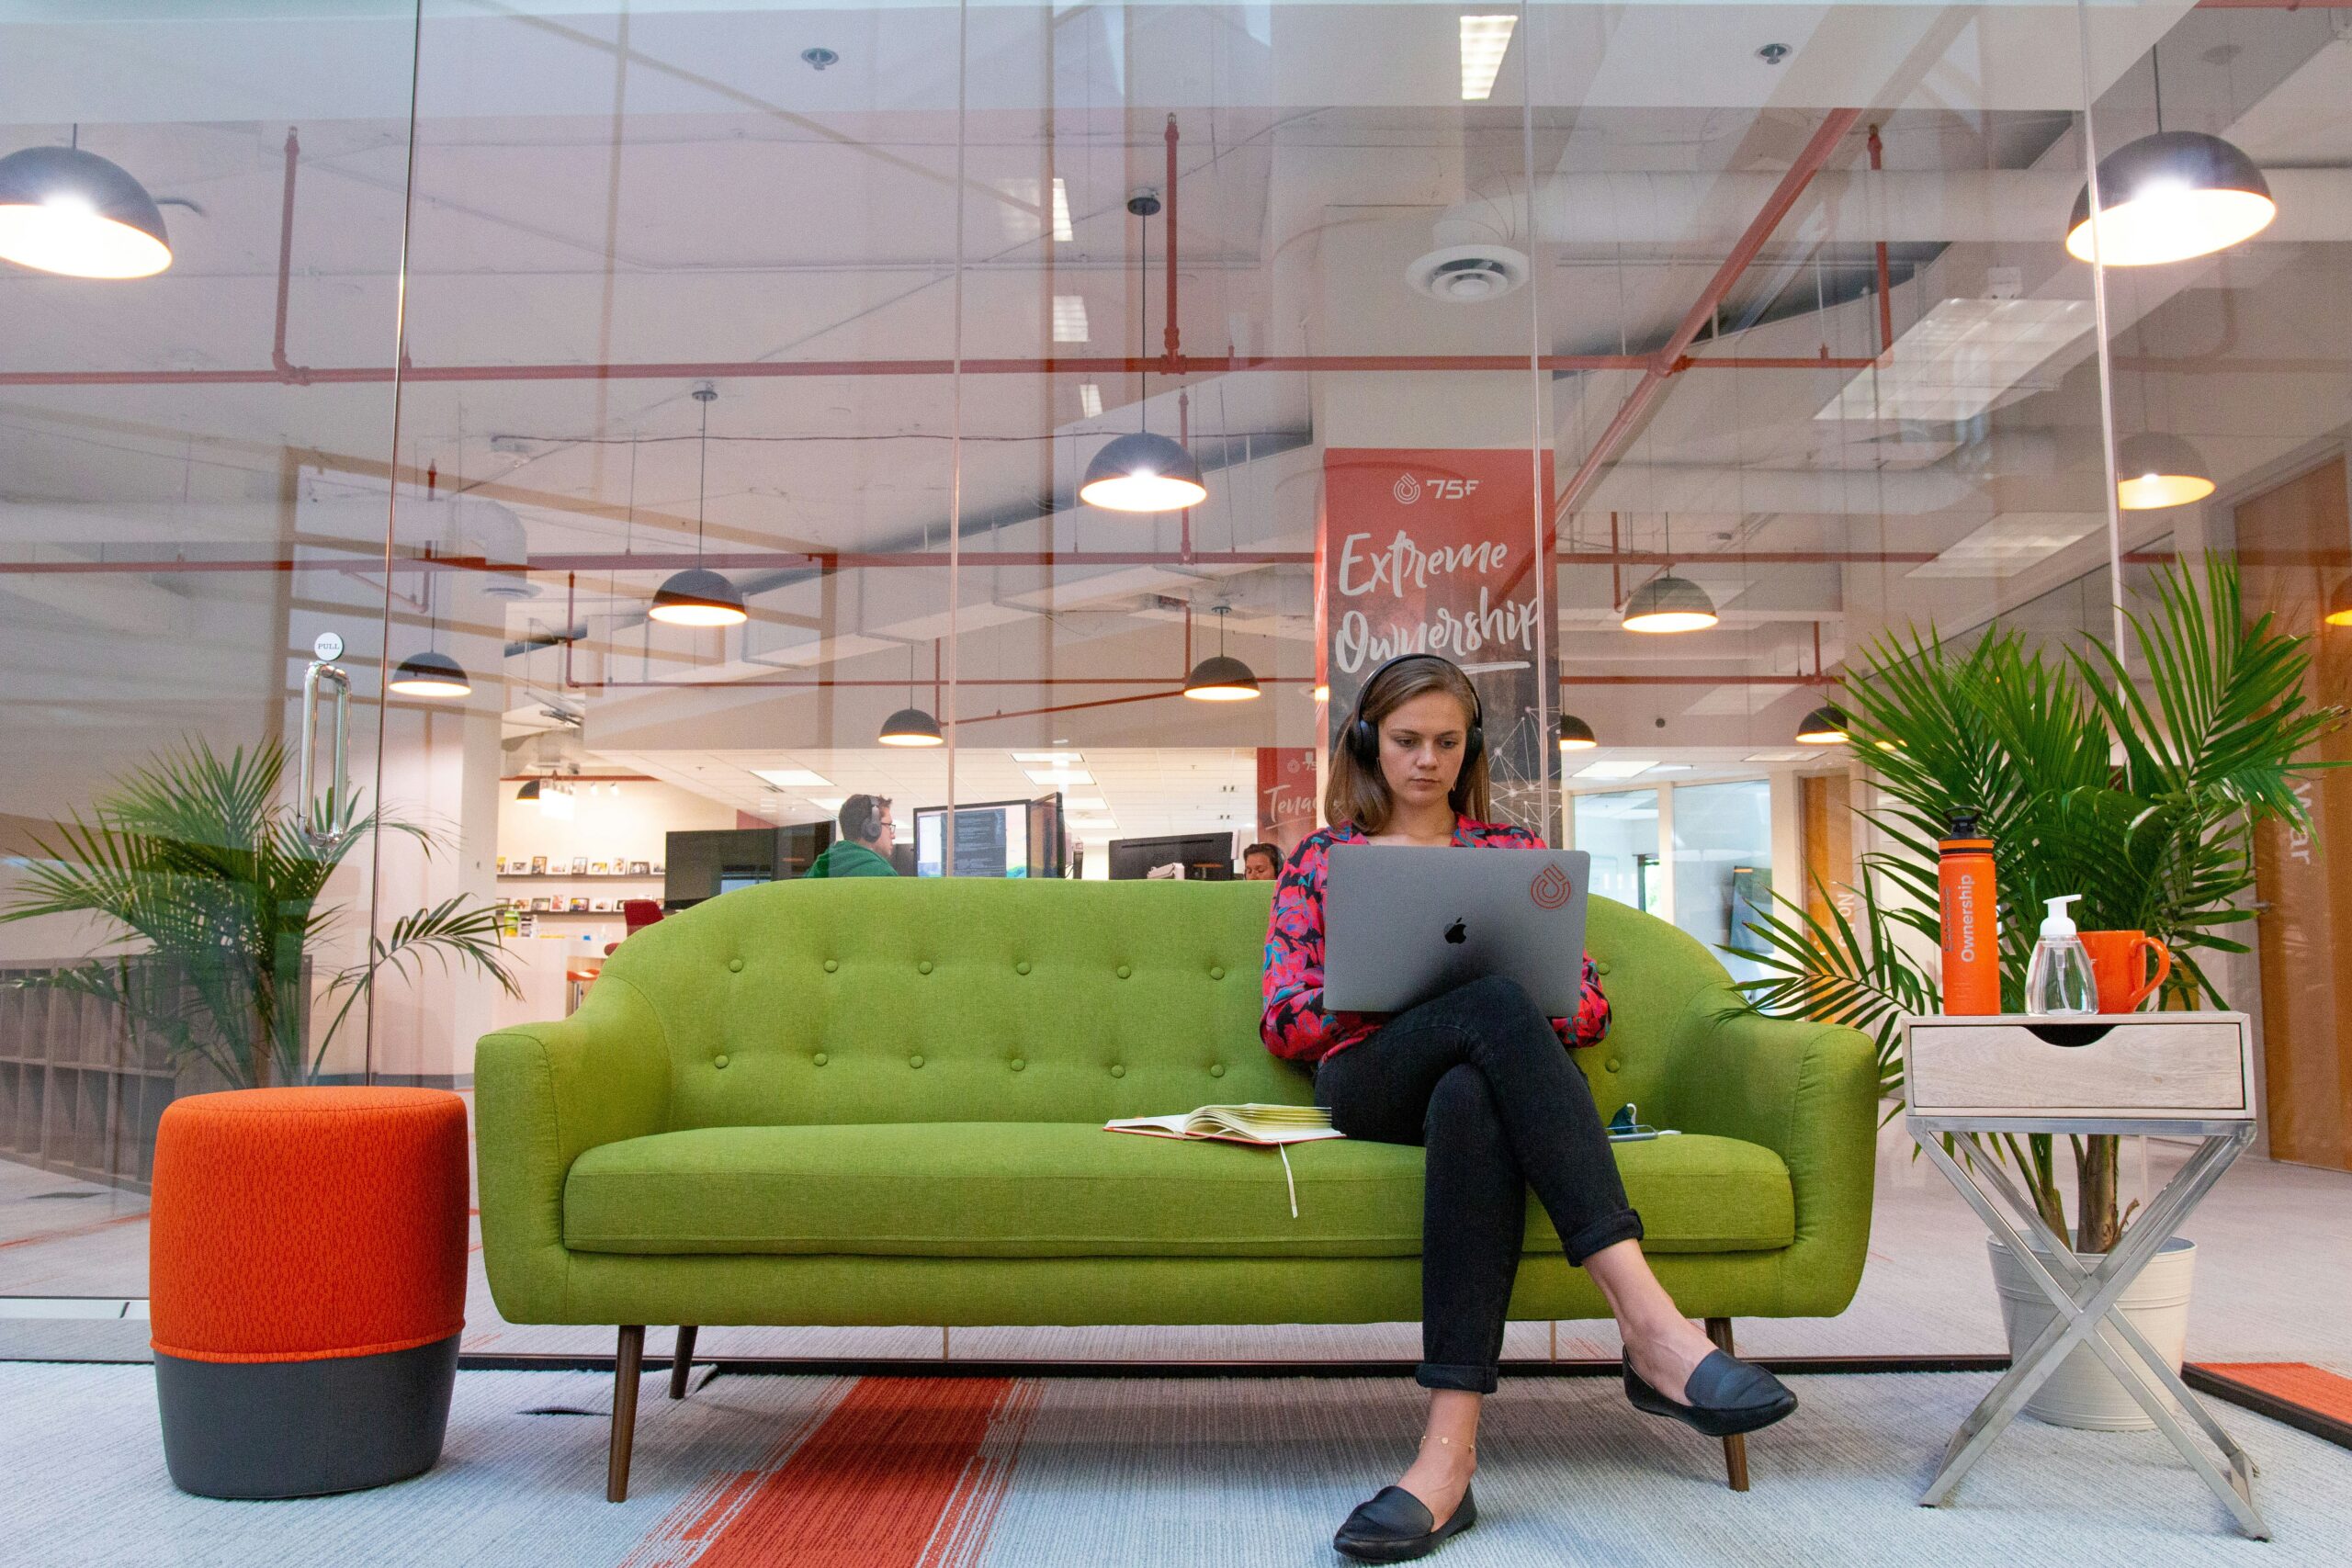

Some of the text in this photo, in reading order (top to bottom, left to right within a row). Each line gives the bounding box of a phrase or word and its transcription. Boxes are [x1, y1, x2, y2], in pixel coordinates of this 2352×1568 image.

[1426, 479, 1479, 501] 75F
[1338, 529, 1509, 598] Extreme
[1335, 586, 1540, 674] Ownership
[1957, 874, 1975, 963] Ownership
